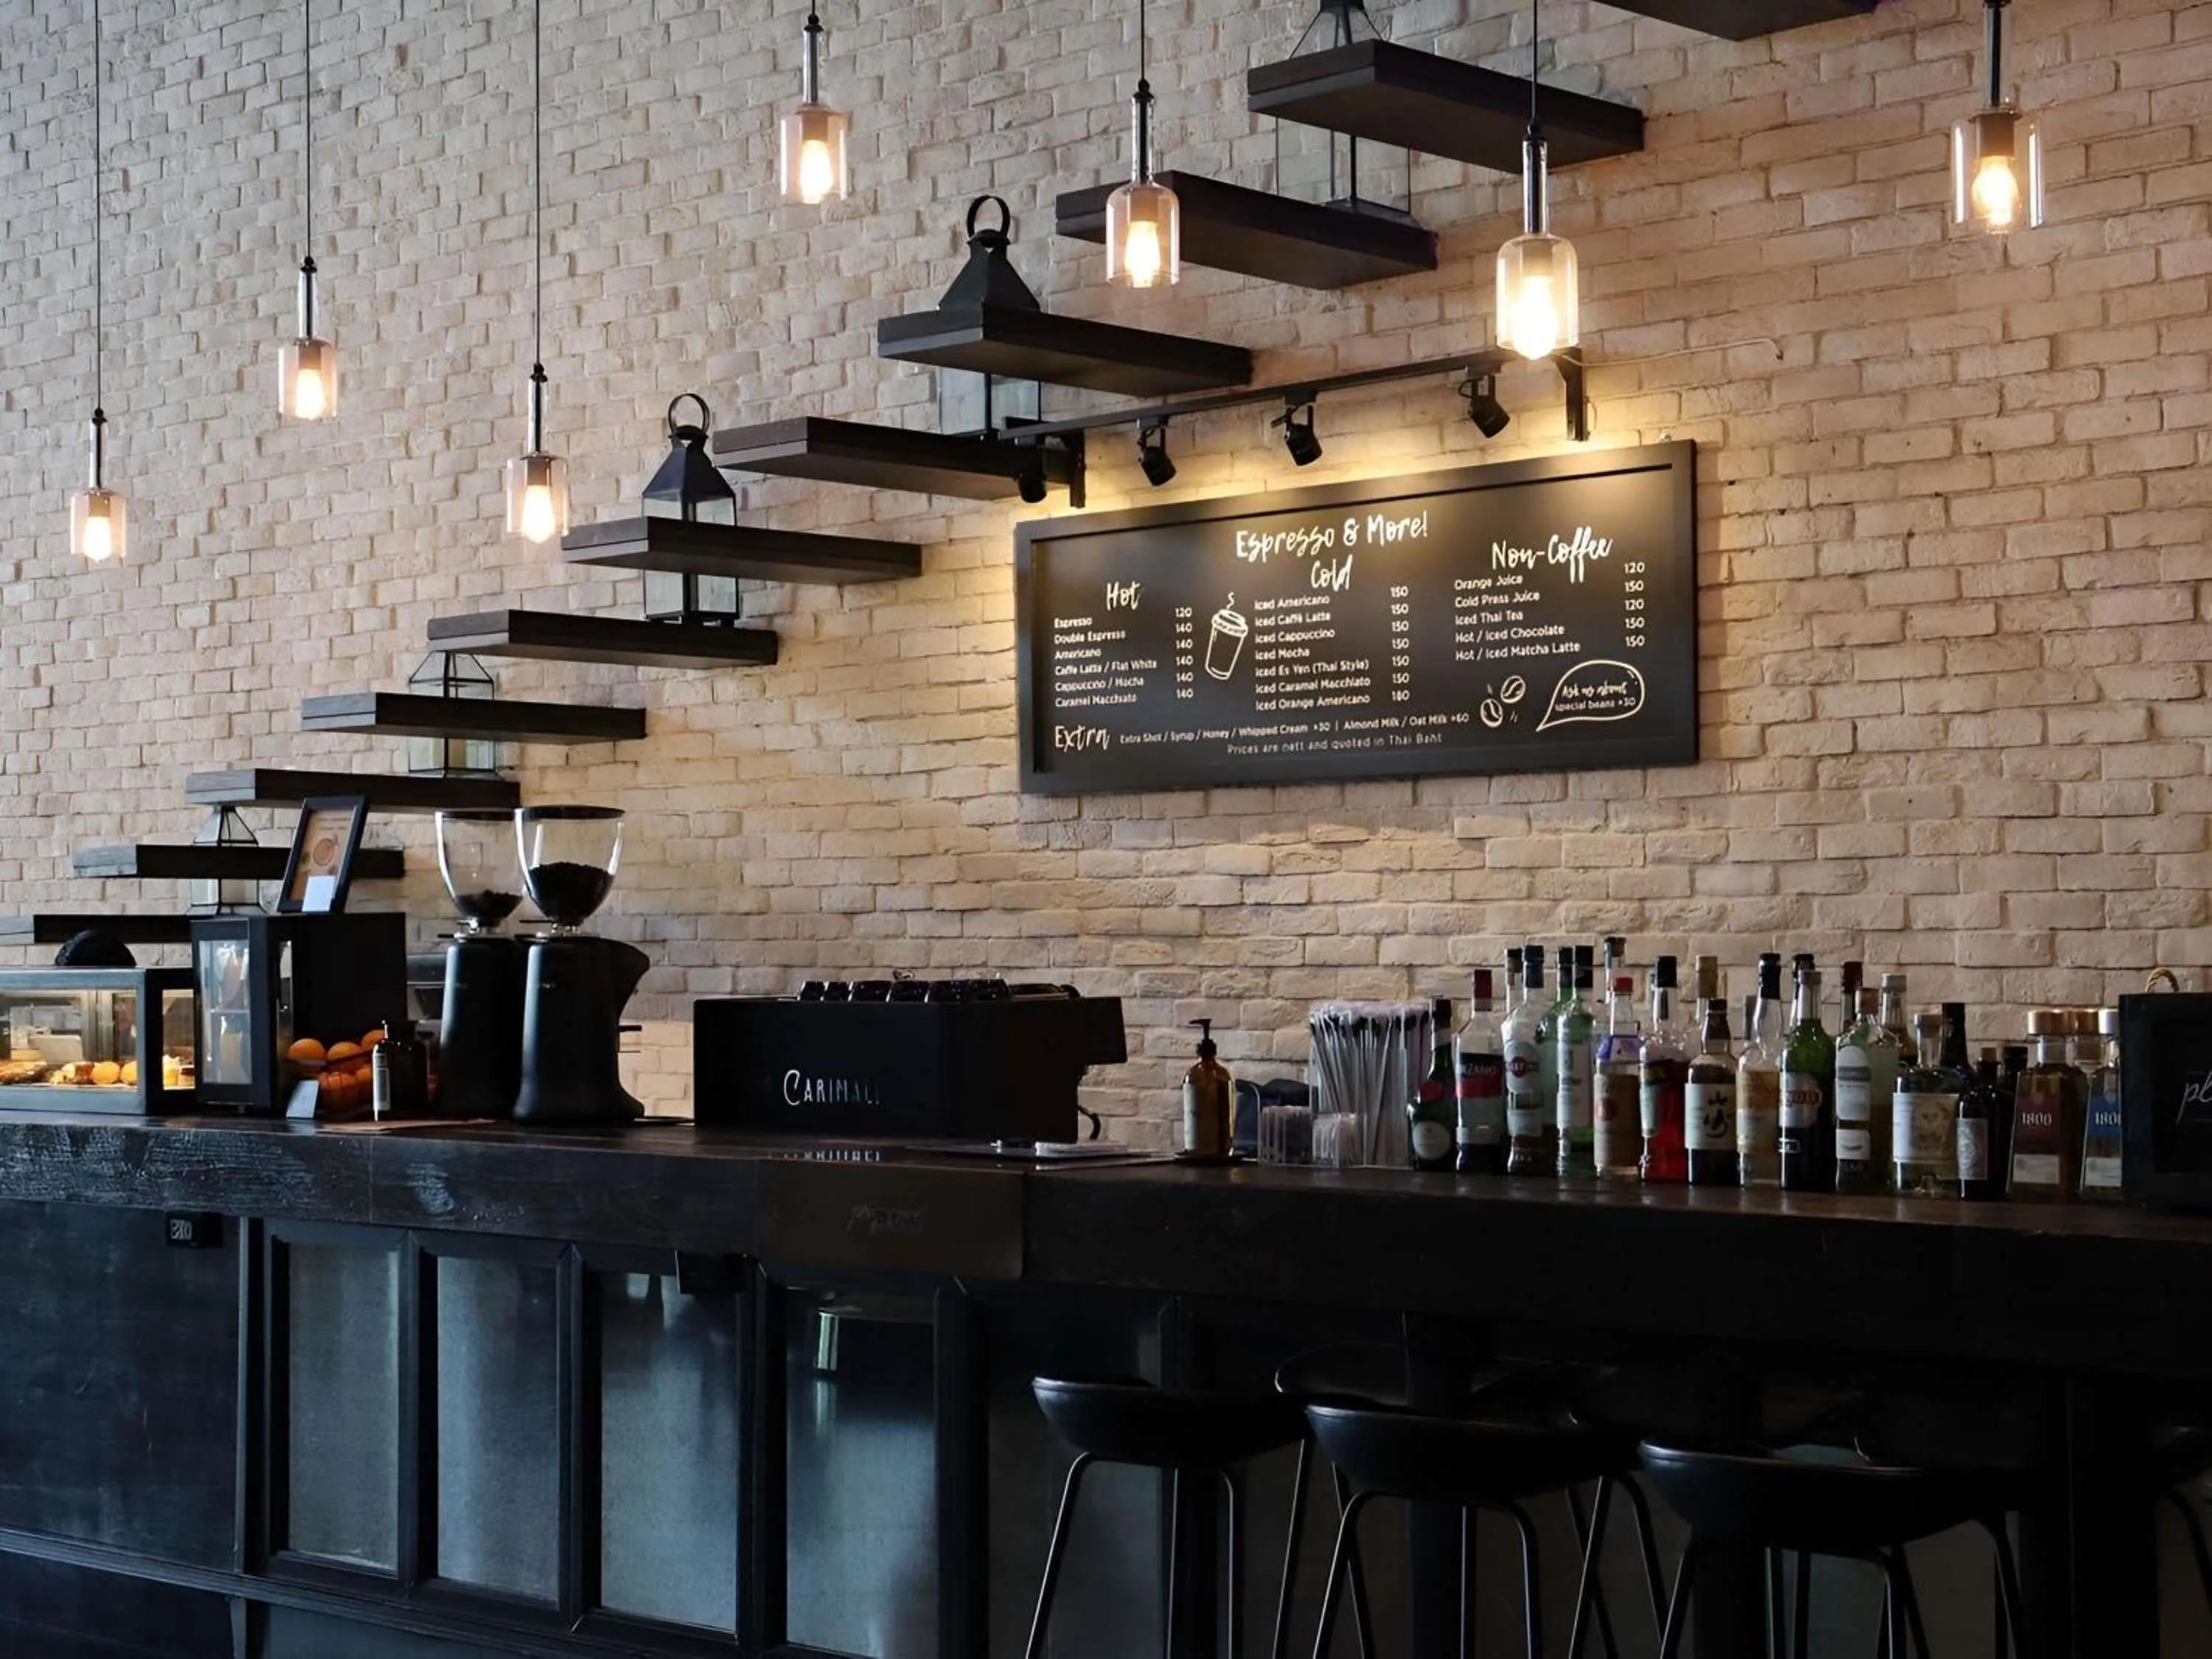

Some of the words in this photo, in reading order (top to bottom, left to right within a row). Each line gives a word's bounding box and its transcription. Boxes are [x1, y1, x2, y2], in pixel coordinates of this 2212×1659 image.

[1236, 526, 1335, 563] Espresso
[1343, 518, 1359, 546] &
[1368, 510, 1428, 547] More!
[1492, 526, 1613, 583] Non-Coffee
[1311, 554, 1353, 592] Cold
[1454, 578, 1492, 591] Orange
[1496, 574, 1523, 587] Juice
[1624, 562, 1645, 574] 120
[1106, 580, 1141, 611] Hot
[1254, 599, 1275, 611] Iced
[1277, 595, 1330, 608] Americano
[1390, 585, 1409, 598] 150
[1455, 596, 1478, 608] Cold
[1481, 594, 1509, 605] Press
[1512, 590, 1540, 603] Juice
[1624, 580, 1644, 593] 150
[1054, 617, 1093, 628] Espresso
[1175, 607, 1192, 617] 120
[1255, 616, 1276, 627] Iced
[1306, 611, 1331, 623] Latte
[1391, 602, 1409, 615] 150
[1455, 613, 1477, 625] Iced
[1481, 611, 1502, 623] Thai
[1506, 610, 1523, 621] Tea
[1625, 599, 1644, 611] 120
[1054, 633, 1085, 644] Double
[1088, 630, 1126, 642] Espresso
[1175, 622, 1193, 633] 140
[1255, 633, 1276, 644] Iced
[1278, 628, 1335, 642] Cappuccino
[1391, 620, 1409, 632] 150
[1455, 631, 1475, 644] Hot
[1476, 630, 1482, 644] /
[1486, 629, 1508, 641] Iced
[1511, 625, 1565, 639] Chocolate
[1625, 617, 1644, 629] 150
[1054, 647, 1102, 660] Americano
[1176, 639, 1193, 649] 140
[1255, 650, 1276, 661] Iced
[1278, 647, 1310, 660] Mocha
[1391, 637, 1409, 650] 150
[1455, 649, 1475, 661] Hot
[1476, 648, 1482, 661] /
[1486, 647, 1508, 658] Iced
[1511, 643, 1548, 657] Matcha
[1552, 641, 1581, 653] Latte
[1625, 635, 1645, 647] 150
[1079, 664, 1102, 674] Latte
[1103, 661, 1110, 673] /
[1111, 661, 1128, 671] Flat
[1130, 659, 1157, 670] White
[1176, 655, 1193, 665] 140
[1255, 666, 1276, 677] Iced
[1312, 661, 1338, 674] (Thai
[1340, 658, 1369, 672] Style)
[1391, 655, 1410, 667] 150
[1054, 681, 1106, 692] Cappuccino
[1107, 677, 1113, 689] /
[1176, 672, 1194, 682] 140
[1256, 682, 1276, 694] Iced
[1278, 678, 1318, 692] Caramel
[1321, 676, 1371, 690] Macchiato
[1392, 672, 1410, 684] 150
[1054, 695, 1091, 707] Caramel
[1092, 693, 1136, 706] Macchiato
[1176, 688, 1194, 698] 140
[1256, 700, 1276, 712] Iced
[1278, 697, 1315, 710] Orange
[1317, 693, 1371, 708] Americano
[1055, 724, 1110, 753] Extra
[1120, 734, 1141, 744] Extra
[1142, 732, 1162, 742] Shot
[1170, 731, 1194, 742] Syrup
[1203, 728, 1229, 740] Honey
[1239, 726, 1278, 738] Whipped
[1280, 724, 1308, 734] Cream
[1343, 719, 1380, 730] Almond
[1380, 717, 1399, 728] Milk
[1409, 716, 1427, 726] Oat
[1228, 742, 1259, 754] Prices
[1262, 741, 1279, 754] are
[1308, 739, 1328, 751] and
[1332, 737, 1370, 751] quoted
[1373, 735, 1385, 746] in
[1389, 734, 1412, 745] Thai
[1416, 733, 1442, 745] Baht
[2021, 1110, 2053, 1127] 1800
